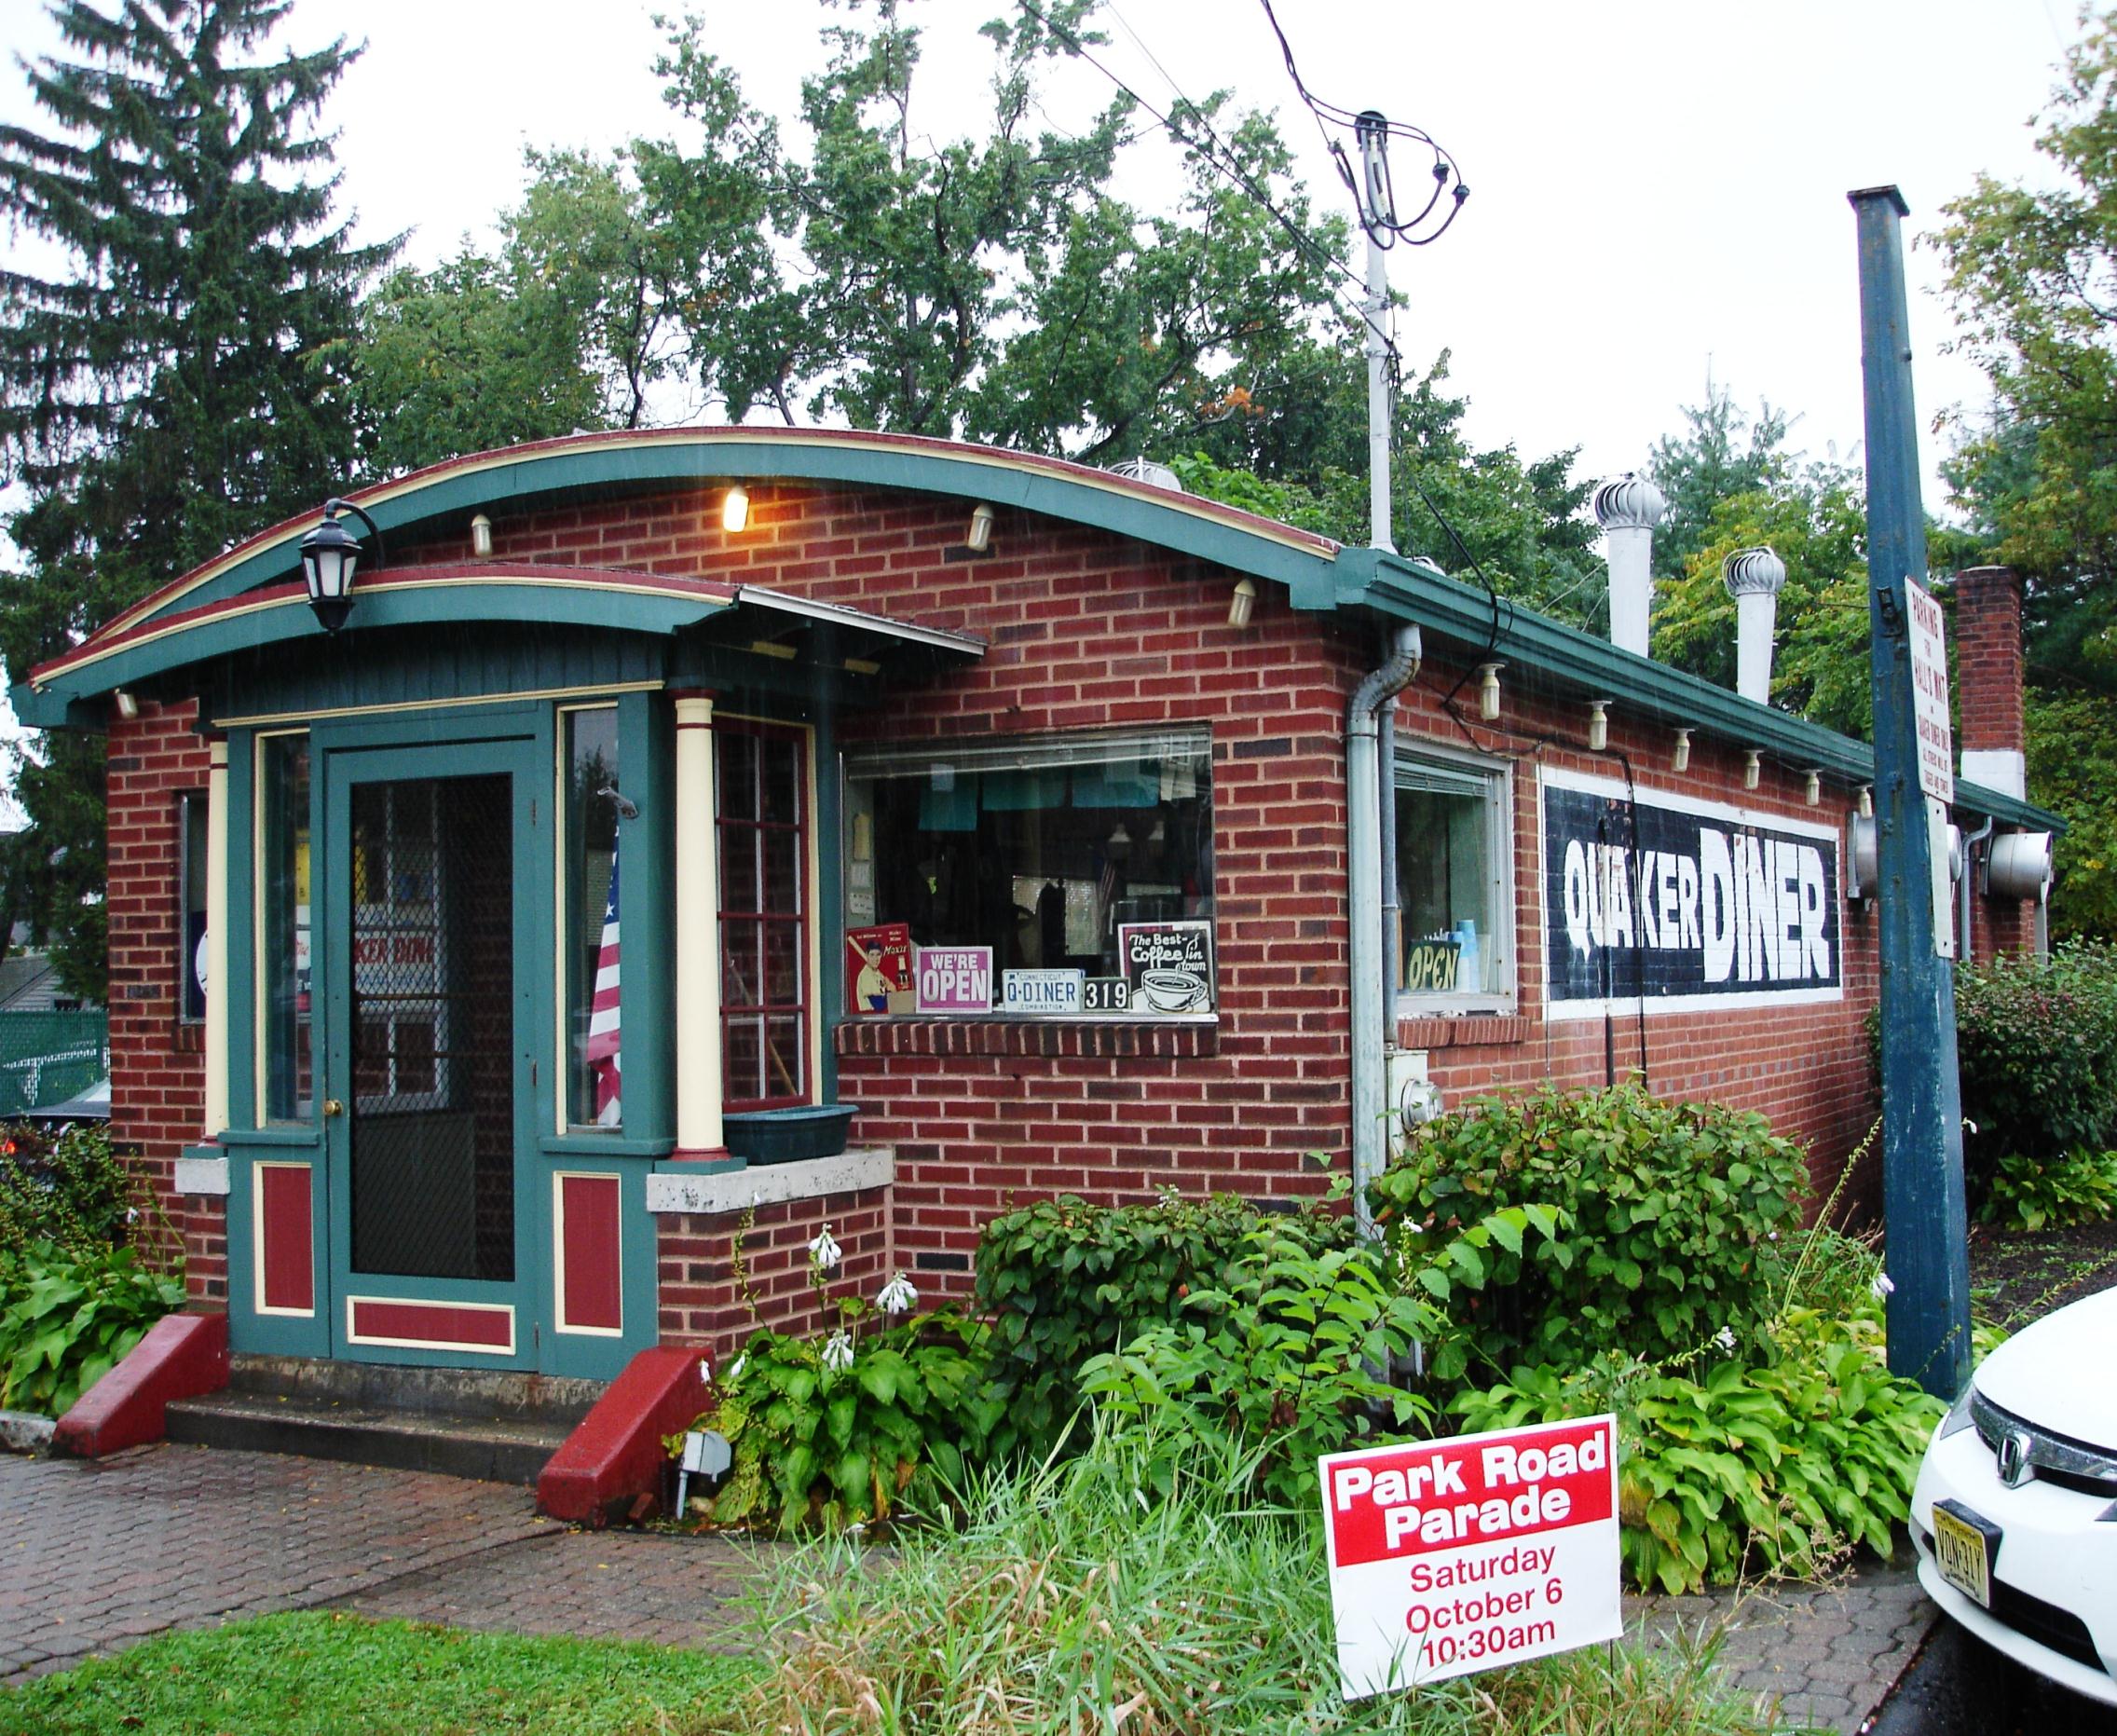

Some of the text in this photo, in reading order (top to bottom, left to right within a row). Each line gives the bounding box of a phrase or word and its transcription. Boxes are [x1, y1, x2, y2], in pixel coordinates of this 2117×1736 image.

[1564, 827, 1830, 983] QUAKER DINER
[1128, 934, 1152, 946] The
[1130, 946, 1203, 969] Coffee in
[931, 953, 978, 970] WE'RE
[1019, 973, 1061, 981] CONNECTICUT
[1181, 959, 1207, 971] town
[1408, 945, 1459, 991] OPEN
[922, 969, 988, 1002] OPEN
[1086, 982, 1127, 1008] 319
[1334, 1430, 1605, 1511] Park Road
[1384, 1484, 1571, 1550] Parade
[1410, 1545, 1556, 1592] Saturday
[1406, 1578, 1564, 1633] October 6
[1422, 1620, 1555, 1668] 10:30am
